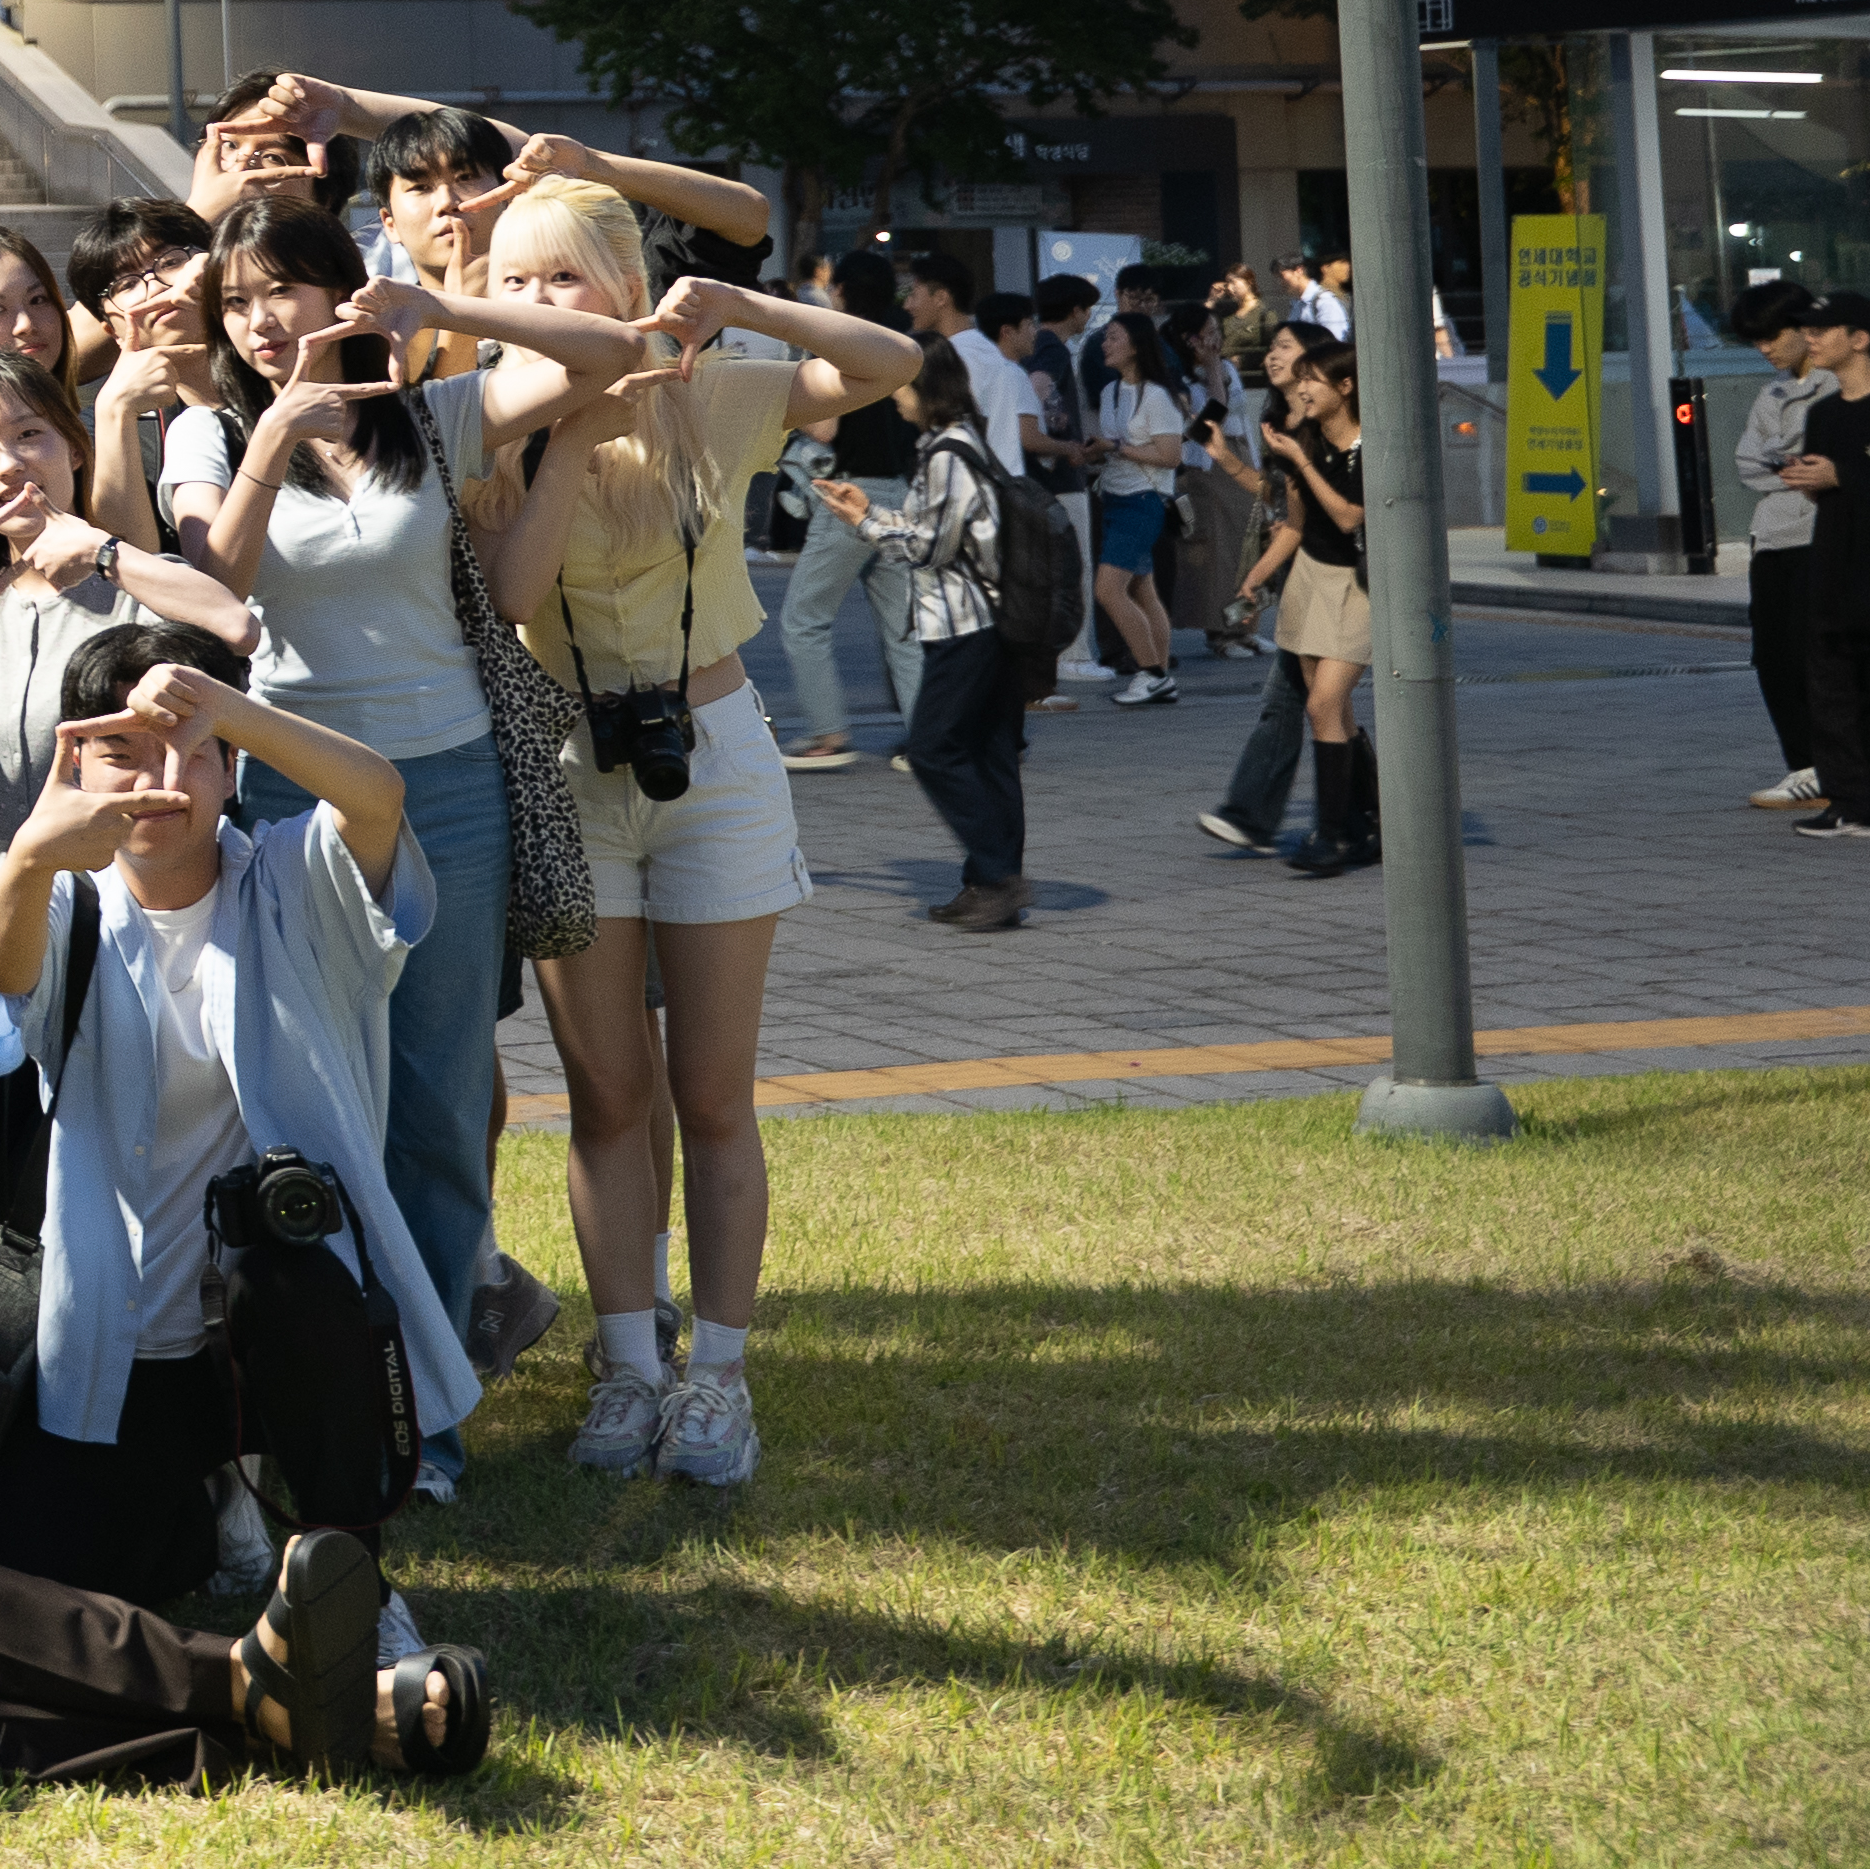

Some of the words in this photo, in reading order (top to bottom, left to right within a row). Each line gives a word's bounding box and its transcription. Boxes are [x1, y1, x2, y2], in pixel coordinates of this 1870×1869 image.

[1519, 247, 1597, 267] 연세대학교
[383, 1338, 407, 1416] DIGITAL
[392, 1419, 411, 1458] EOS
